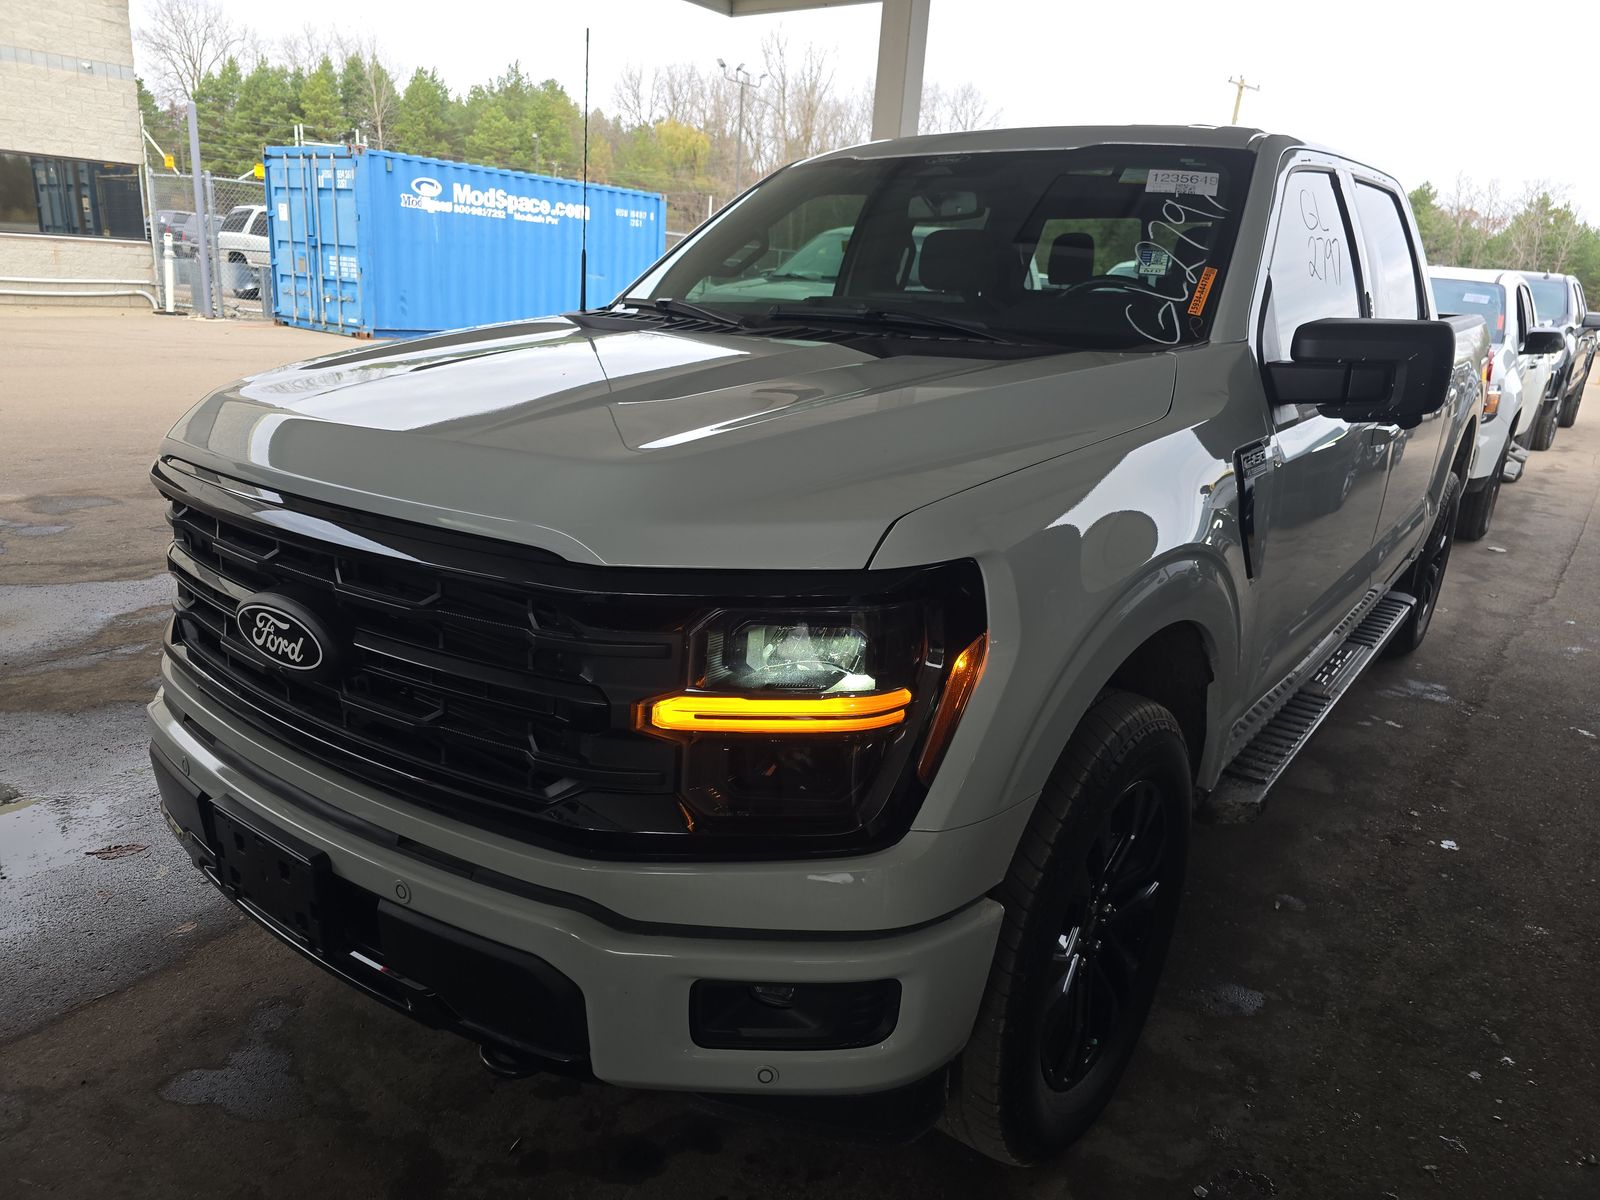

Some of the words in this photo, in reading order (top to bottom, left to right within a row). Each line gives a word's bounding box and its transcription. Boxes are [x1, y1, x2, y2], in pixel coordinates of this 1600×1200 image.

[452, 182, 591, 221] ModSpace.com
[1307, 235, 1342, 287] 2797
[252, 611, 304, 663] Ford
